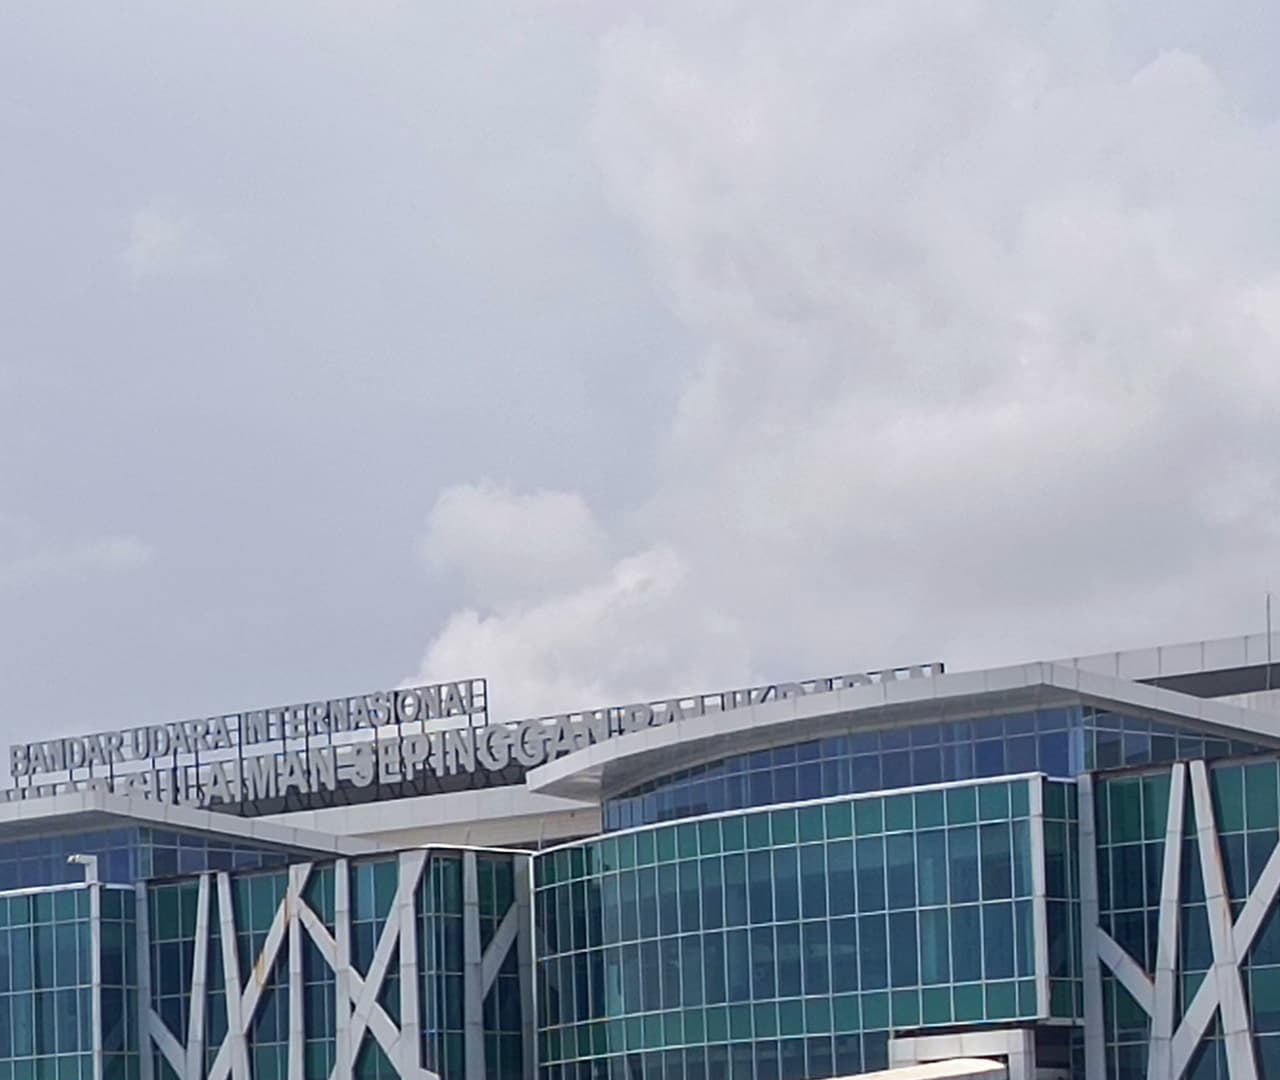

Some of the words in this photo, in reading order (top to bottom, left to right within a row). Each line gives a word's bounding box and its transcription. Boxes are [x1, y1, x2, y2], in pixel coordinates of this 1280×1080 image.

[10, 731, 124, 776] BANDAR
[129, 716, 232, 761] UDARA
[241, 680, 484, 743] INTERNASIONAL
[353, 708, 610, 788] SEPINGGAN
